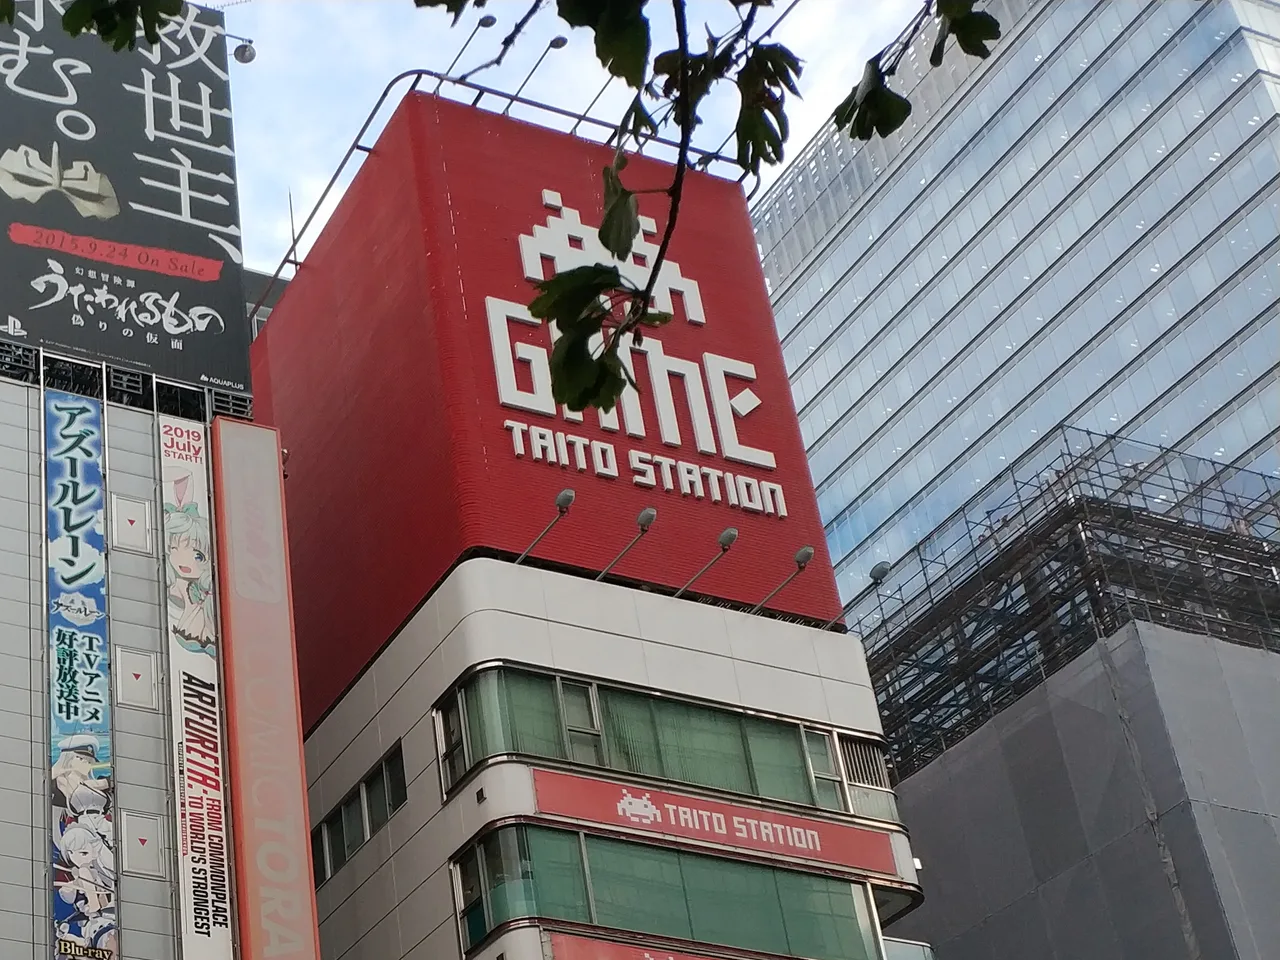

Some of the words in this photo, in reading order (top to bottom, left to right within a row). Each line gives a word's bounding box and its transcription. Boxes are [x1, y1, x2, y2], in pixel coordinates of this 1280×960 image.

[32, 230, 129, 262] 2015.9.24
[137, 254, 161, 269] On
[168, 259, 207, 277] Sale
[28, 258, 226, 336] うたわれるもの
[71, 314, 183, 351] 偽りの仮面
[209, 376, 245, 391] AQUAPLUS
[163, 424, 202, 442] 2019
[164, 436, 203, 456] July
[164, 450, 203, 465] START!
[504, 420, 619, 478] TAITO
[628, 449, 788, 519] STATION
[52, 402, 97, 586] アズールレーン
[55, 628, 80, 721] 好評放送中
[81, 634, 103, 722] TVアニメ
[188, 795, 204, 810] TO
[206, 797, 223, 832] FROM
[188, 811, 207, 867] WORLD'S
[663, 803, 727, 835] TAITO
[733, 815, 822, 851] STATION
[192, 867, 212, 938] STRONGEST
[206, 833, 229, 929] COMMONPLACE
